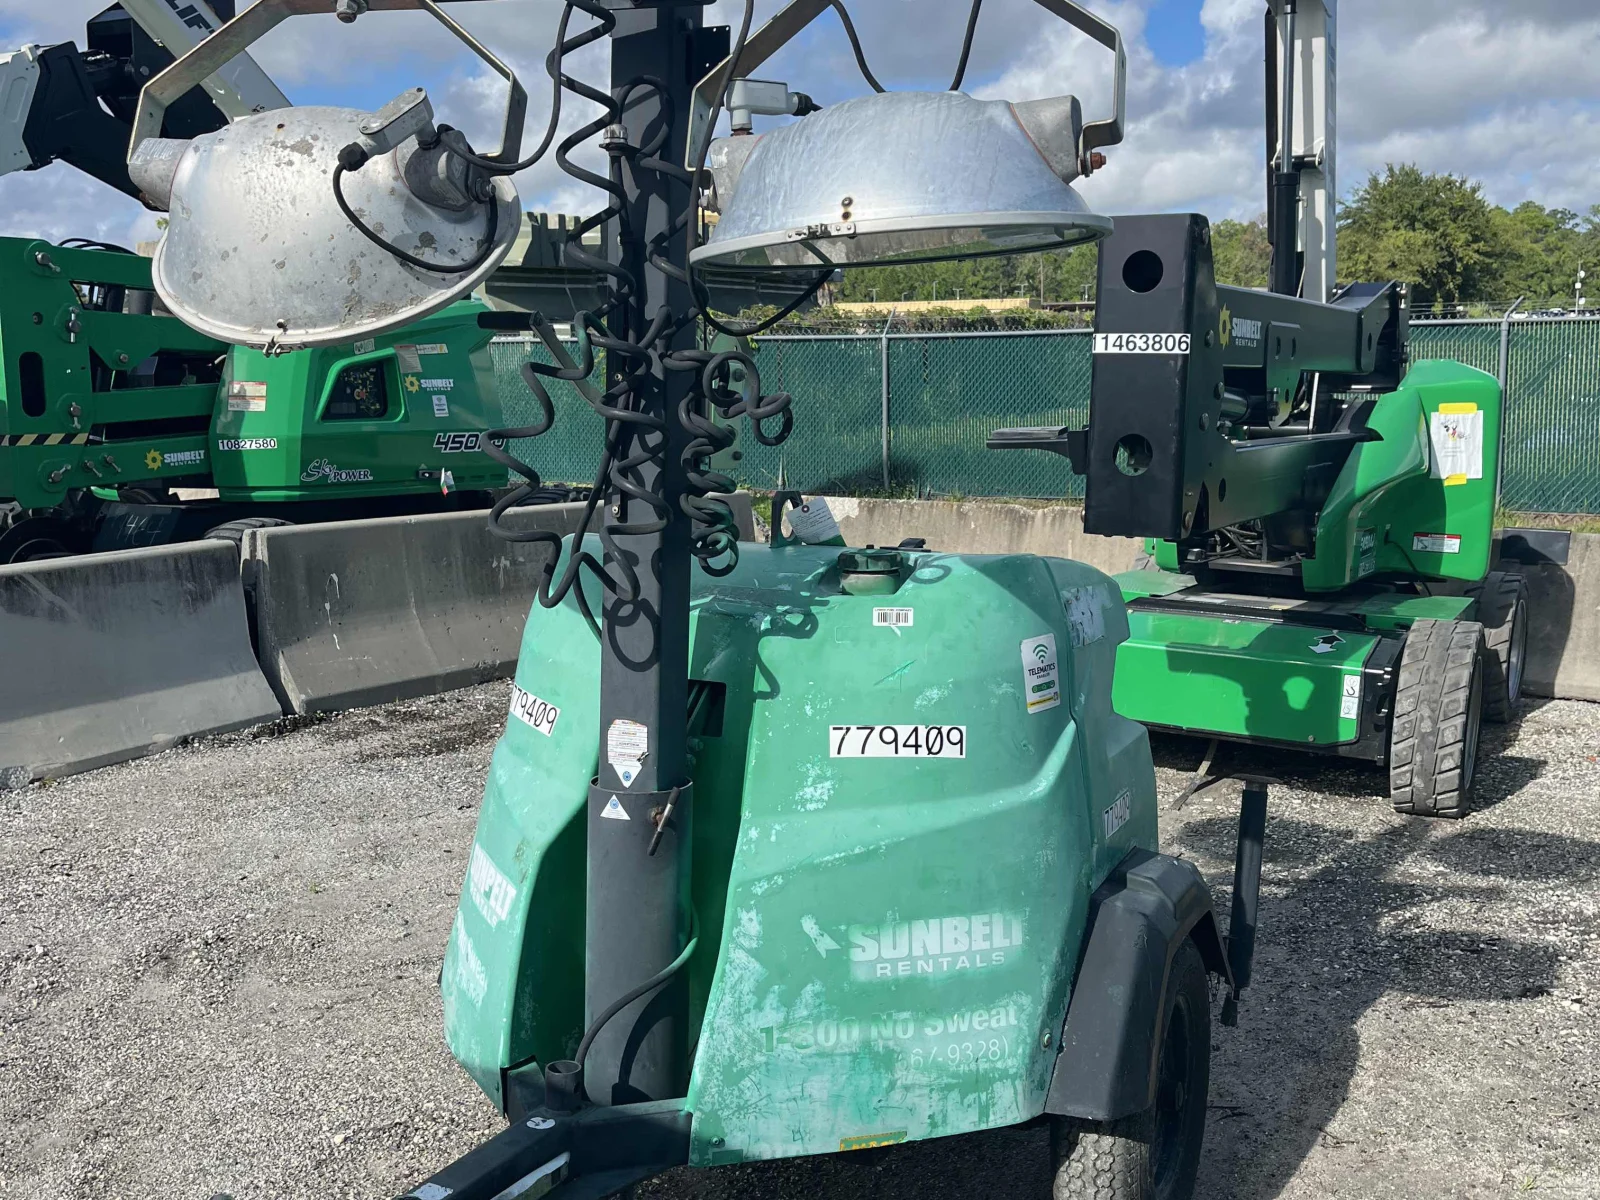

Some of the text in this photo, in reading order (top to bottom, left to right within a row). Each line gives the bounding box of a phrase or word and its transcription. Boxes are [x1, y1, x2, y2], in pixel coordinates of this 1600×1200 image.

[1232, 317, 1261, 339] SUNBELT
[1235, 338, 1257, 347] RENTALS
[420, 379, 454, 388] SUNBELT
[219, 438, 276, 450] 10827580
[164, 450, 205, 463] SUNBELT
[1027, 662, 1056, 677] TELEMATICS
[832, 725, 964, 756] 779409
[876, 951, 1006, 978] RENTALS
[870, 1011, 915, 1041] No
[924, 1005, 1019, 1037] Sweat
